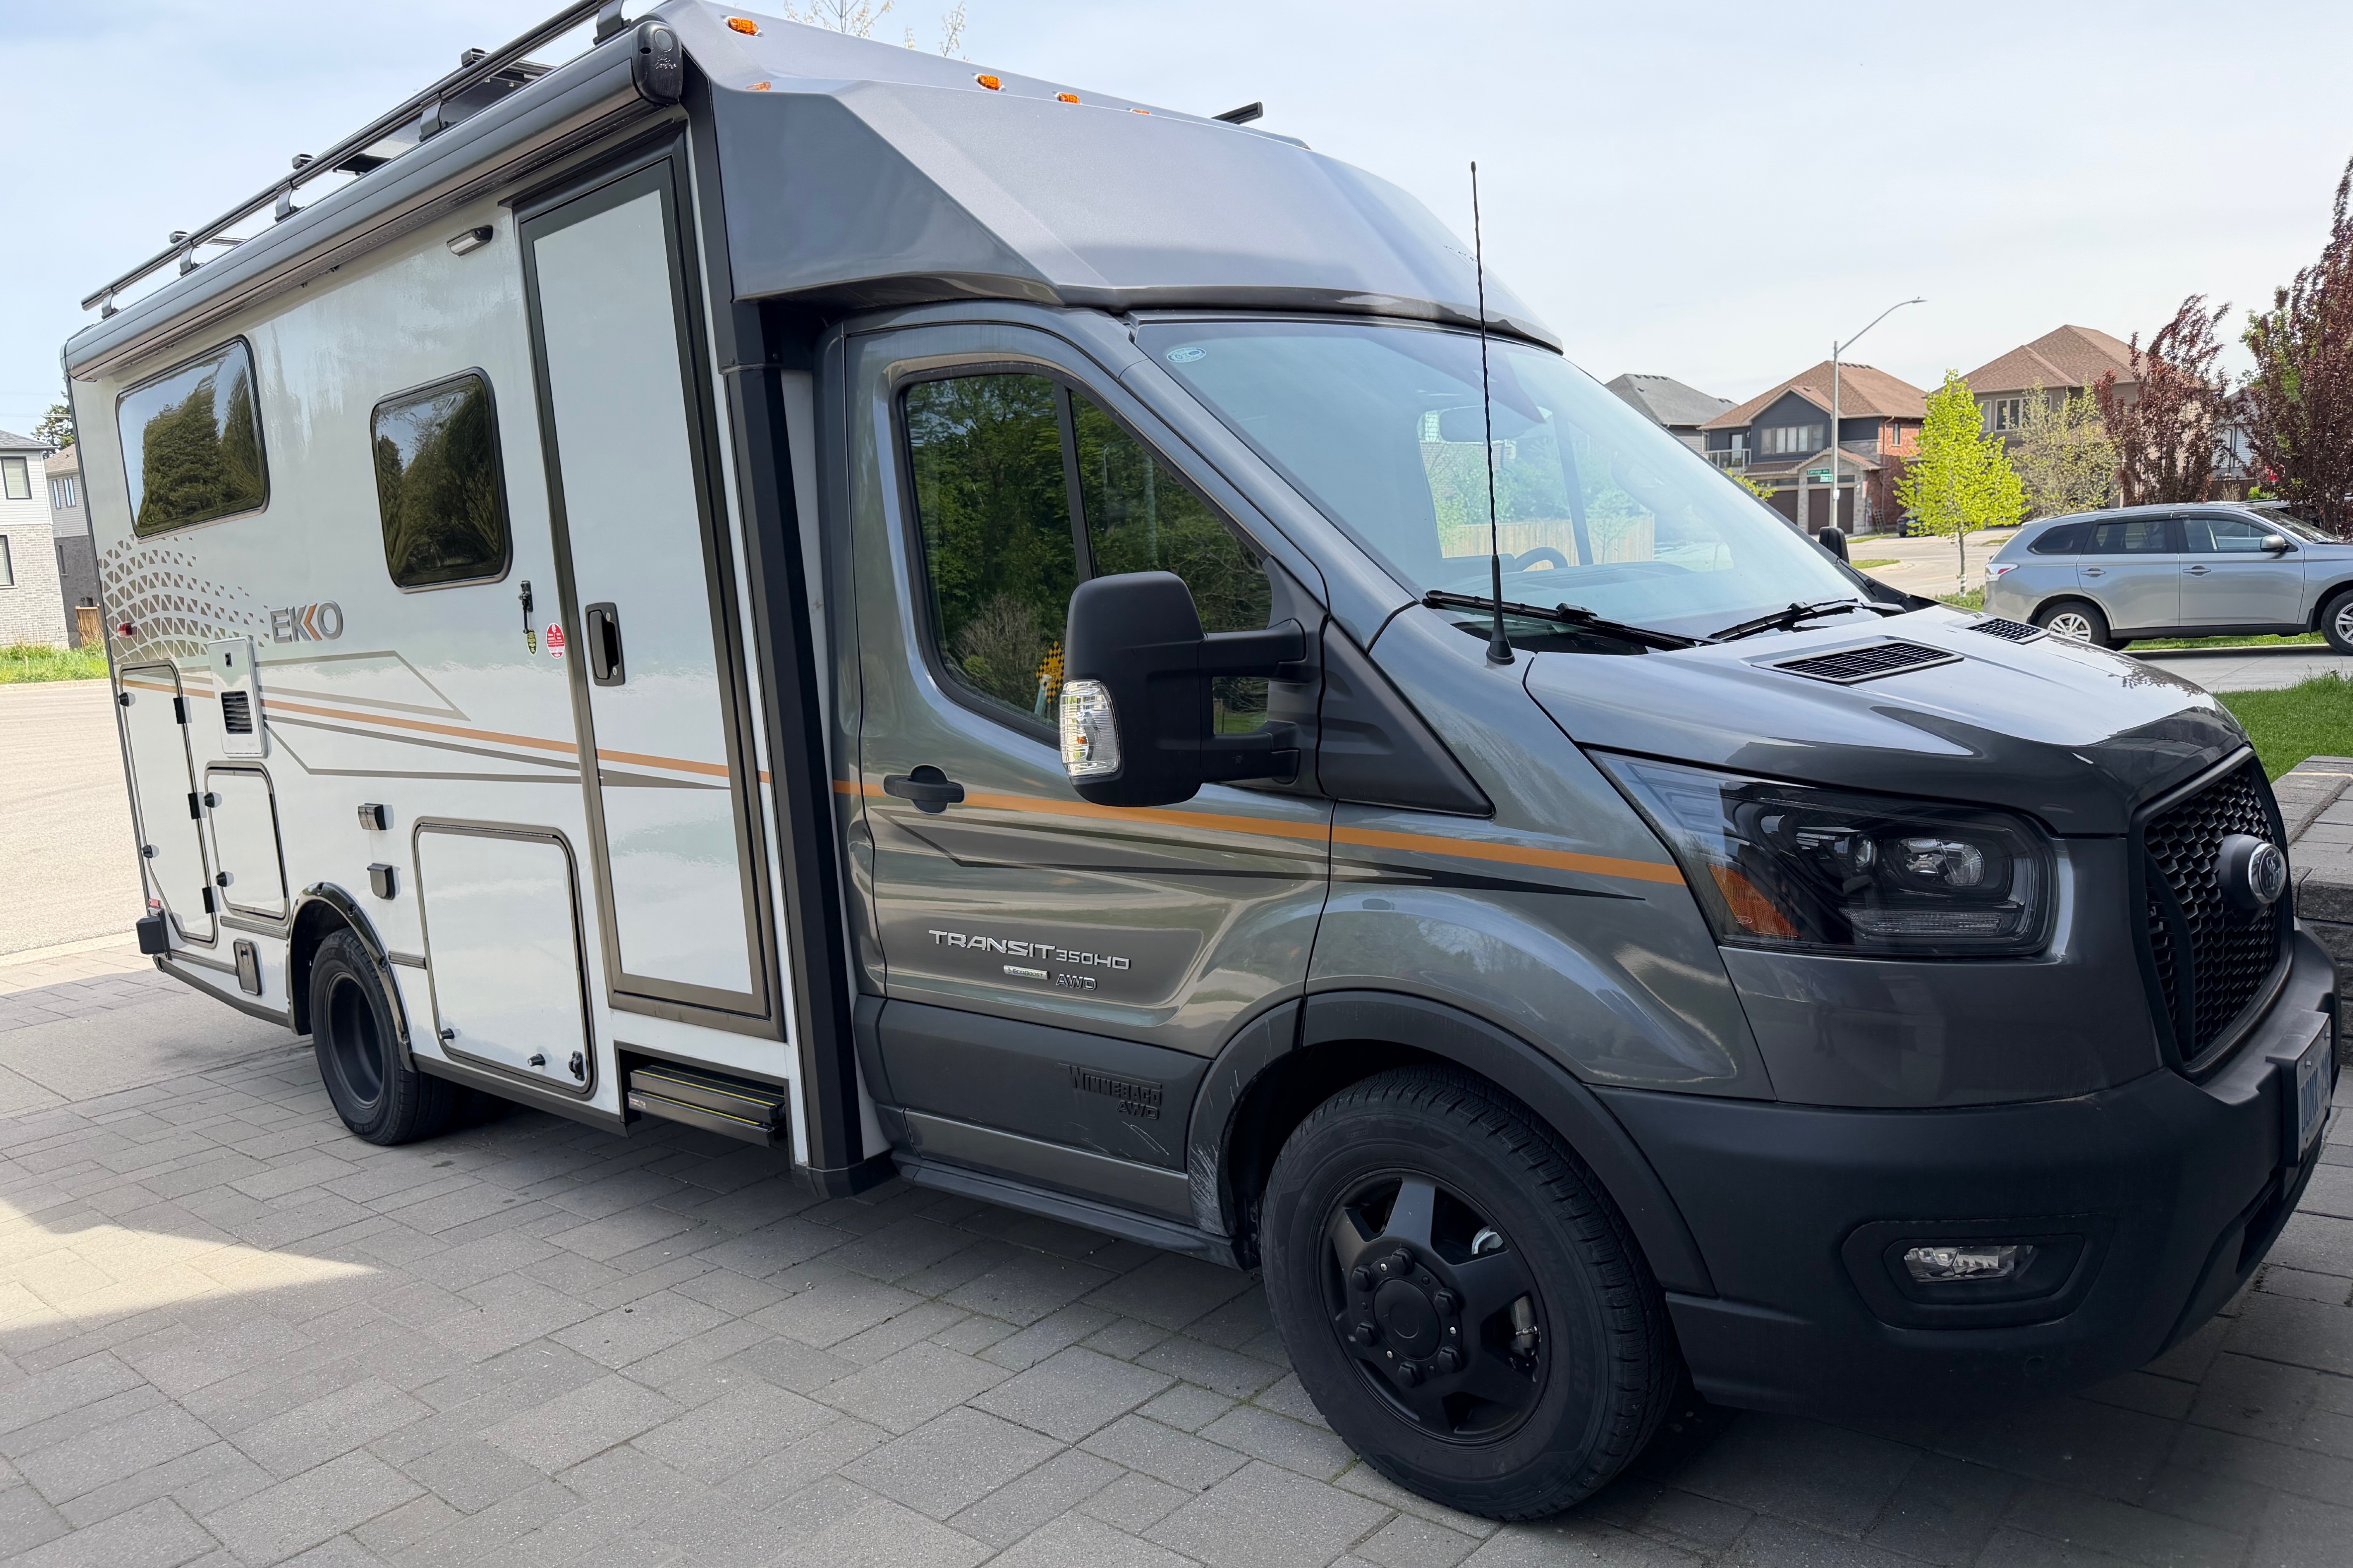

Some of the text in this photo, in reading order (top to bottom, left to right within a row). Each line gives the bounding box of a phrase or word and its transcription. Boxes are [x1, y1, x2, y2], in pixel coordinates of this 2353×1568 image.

[270, 600, 343, 644] EKKO
[928, 930, 1130, 970] TRANSIT 350HD
[1055, 973, 1097, 990] AWD
[1068, 1065, 1162, 1106] WINNEBAGO
[1117, 1100, 1159, 1120] AWD
